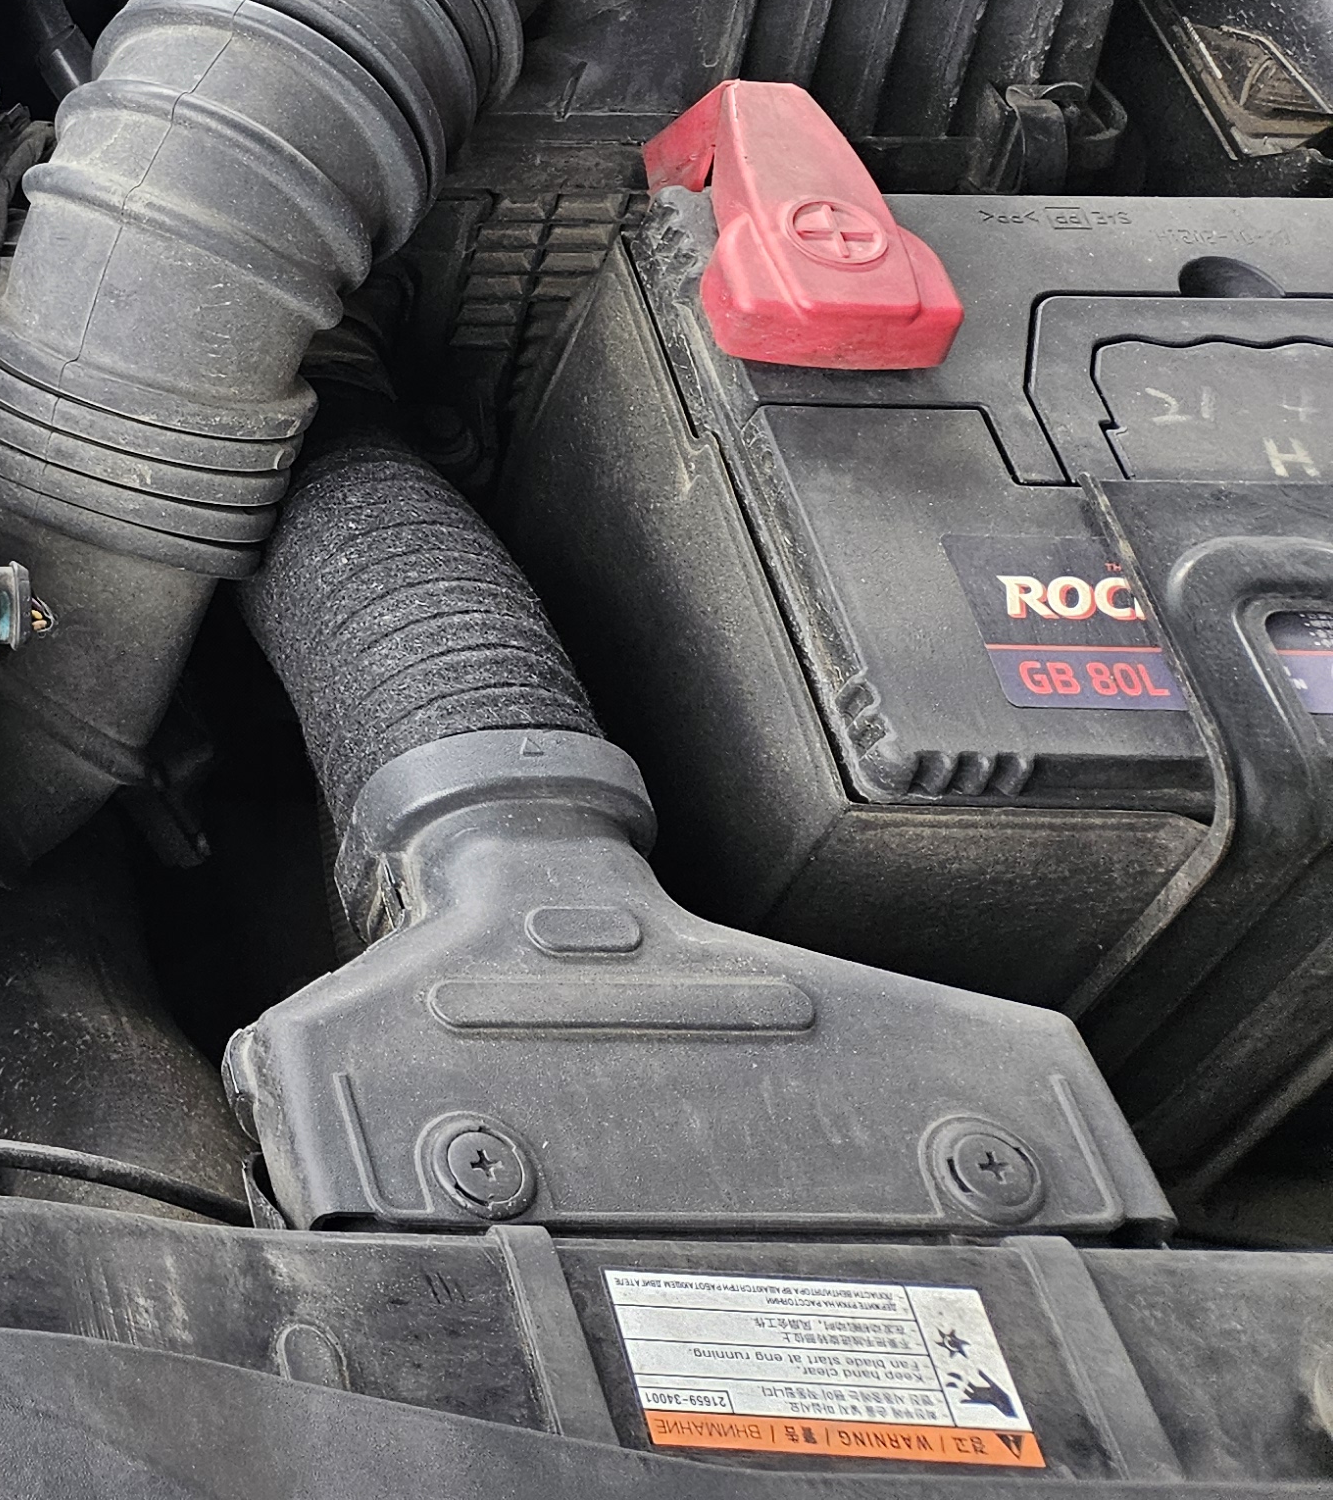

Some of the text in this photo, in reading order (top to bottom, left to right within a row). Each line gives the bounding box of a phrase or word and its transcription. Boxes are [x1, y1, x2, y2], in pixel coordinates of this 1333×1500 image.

[996, 574, 1146, 621] ROC
[1018, 660, 1171, 697] GB 80L
[688, 1347, 920, 1372] Fan blade start at eng running.
[796, 1366, 925, 1383] Keep hand clear.
[645, 1391, 726, 1408] 21659-34001
[653, 1418, 762, 1440] ВНИМАНИЕ
[838, 1430, 933, 1452] WARNING
